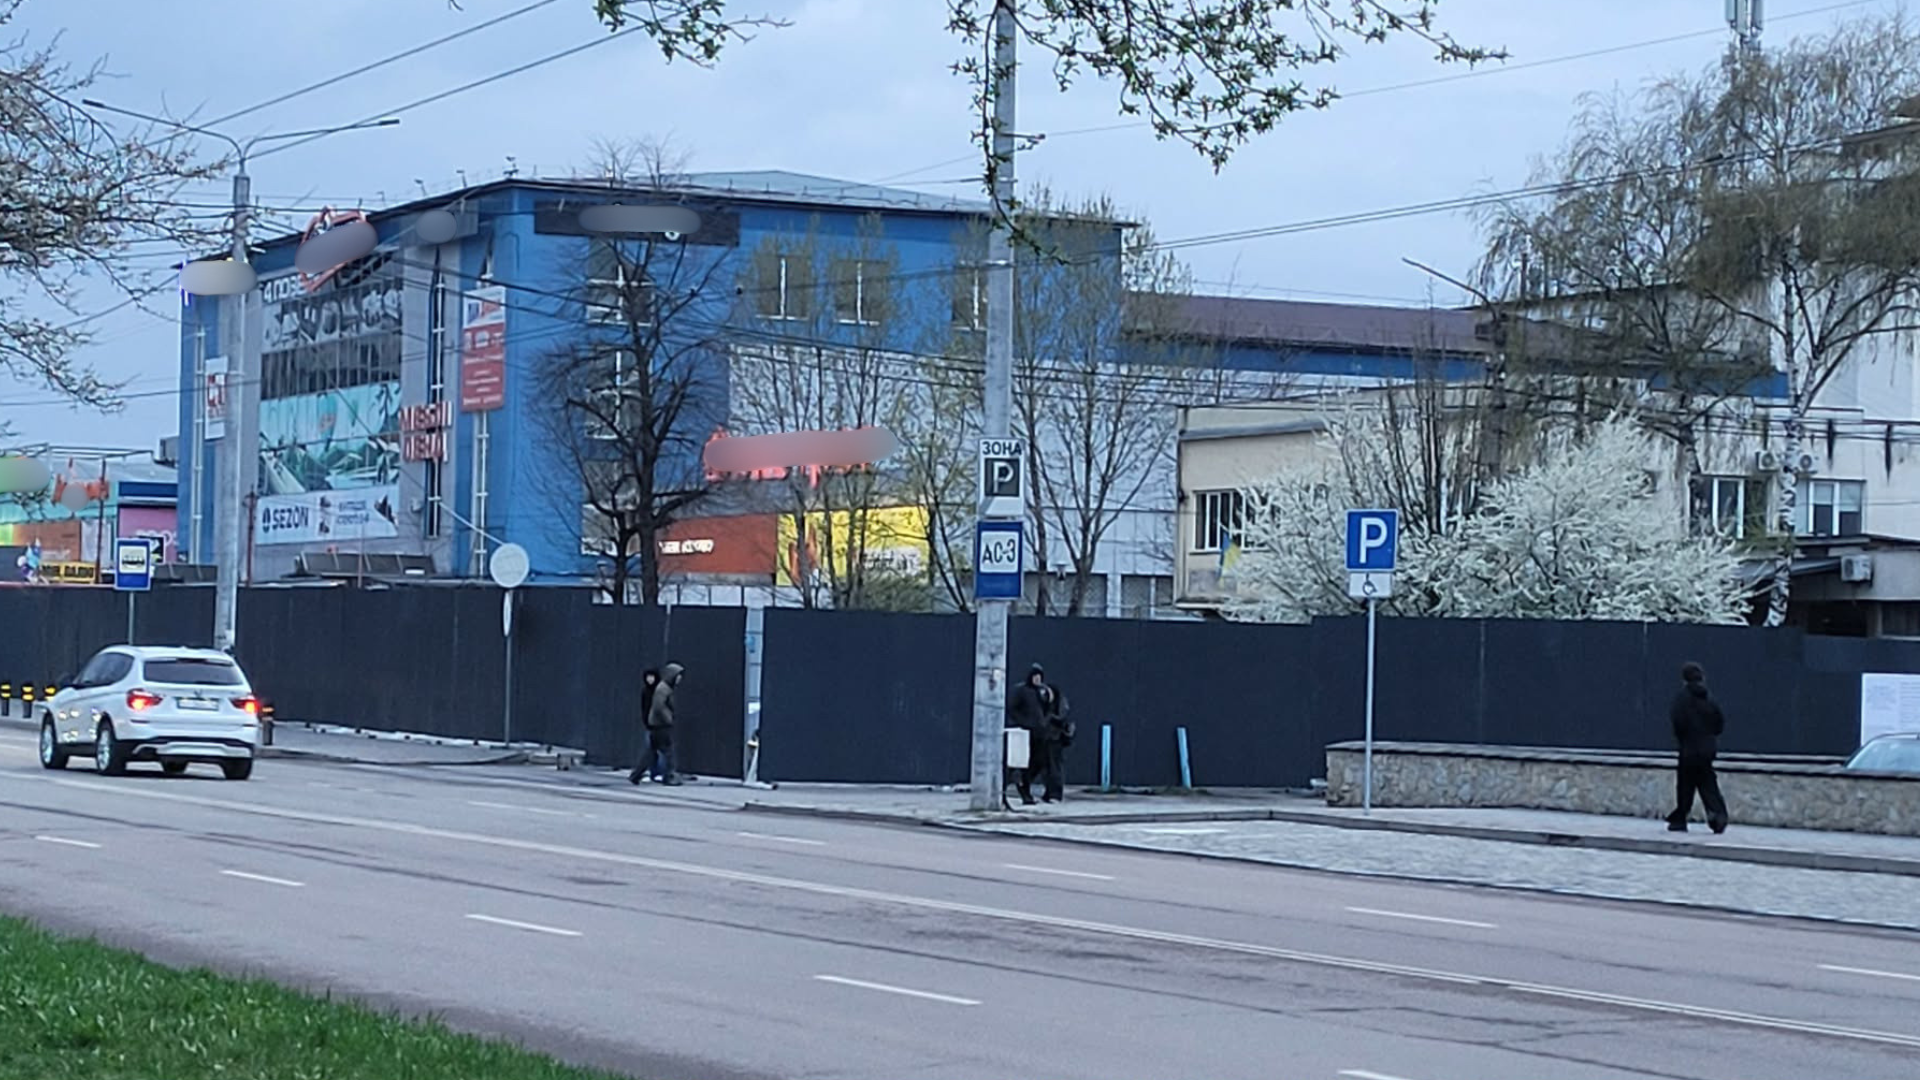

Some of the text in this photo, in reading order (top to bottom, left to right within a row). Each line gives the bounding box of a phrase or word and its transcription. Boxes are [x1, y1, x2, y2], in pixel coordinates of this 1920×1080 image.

[982, 441, 1022, 456] ЗОНА
[993, 461, 1014, 493] P
[272, 505, 309, 531] SEZON
[1359, 517, 1388, 564] P
